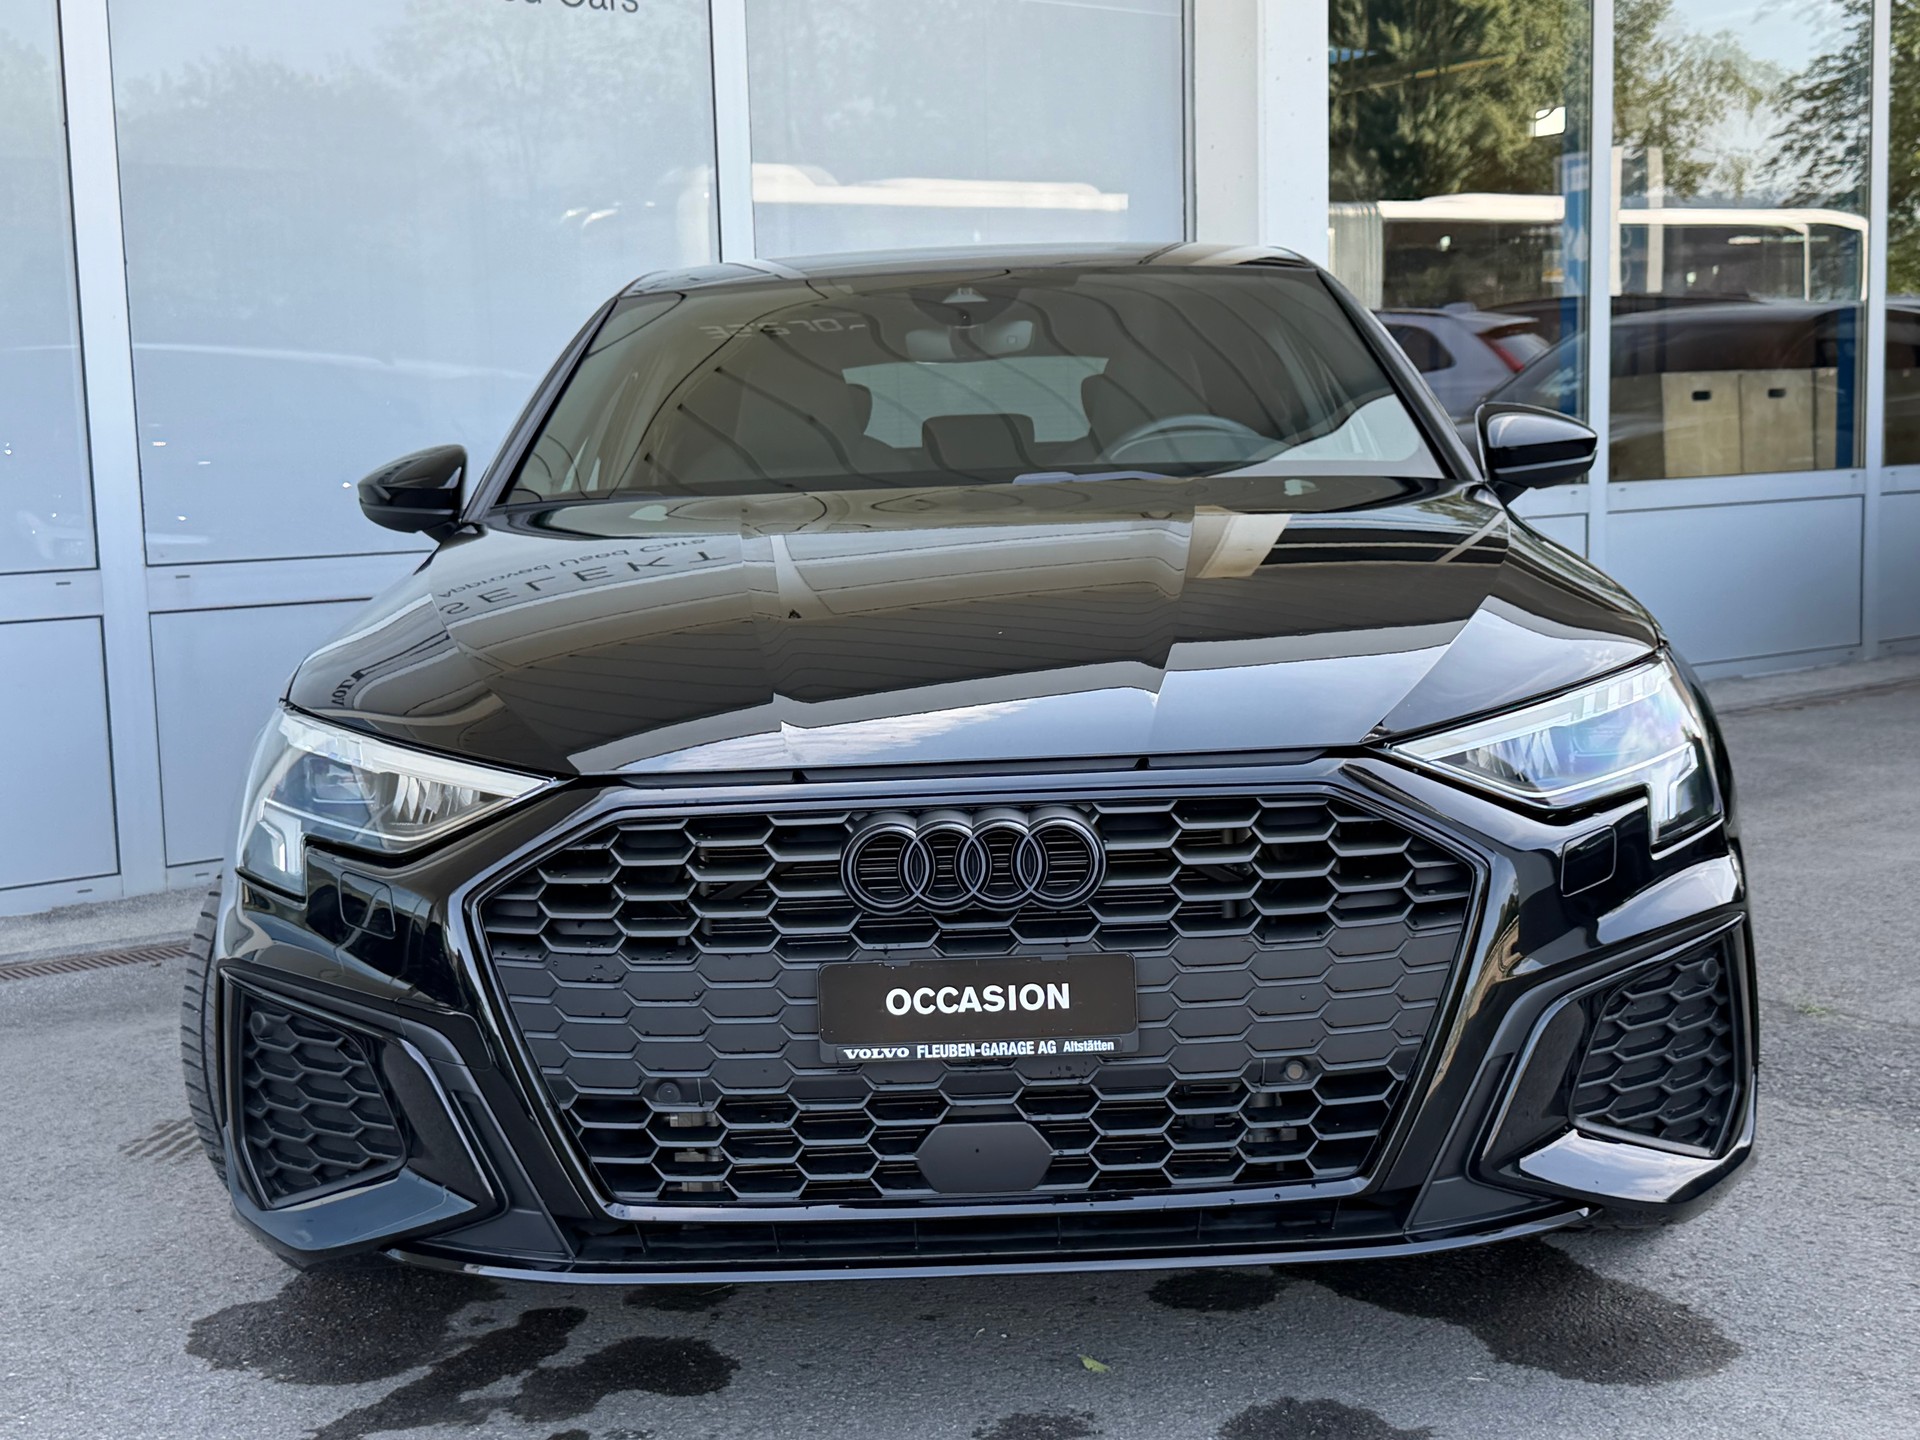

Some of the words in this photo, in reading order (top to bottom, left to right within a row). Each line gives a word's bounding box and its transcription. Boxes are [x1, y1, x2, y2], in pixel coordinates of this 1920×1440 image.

[885, 982, 1070, 1016] OCCASION
[843, 1046, 910, 1060] VOLVO
[916, 1041, 1035, 1059] FLEUBEN-GARAGE
[1038, 1040, 1057, 1054] AG
[1063, 1039, 1115, 1053] Altstätten
